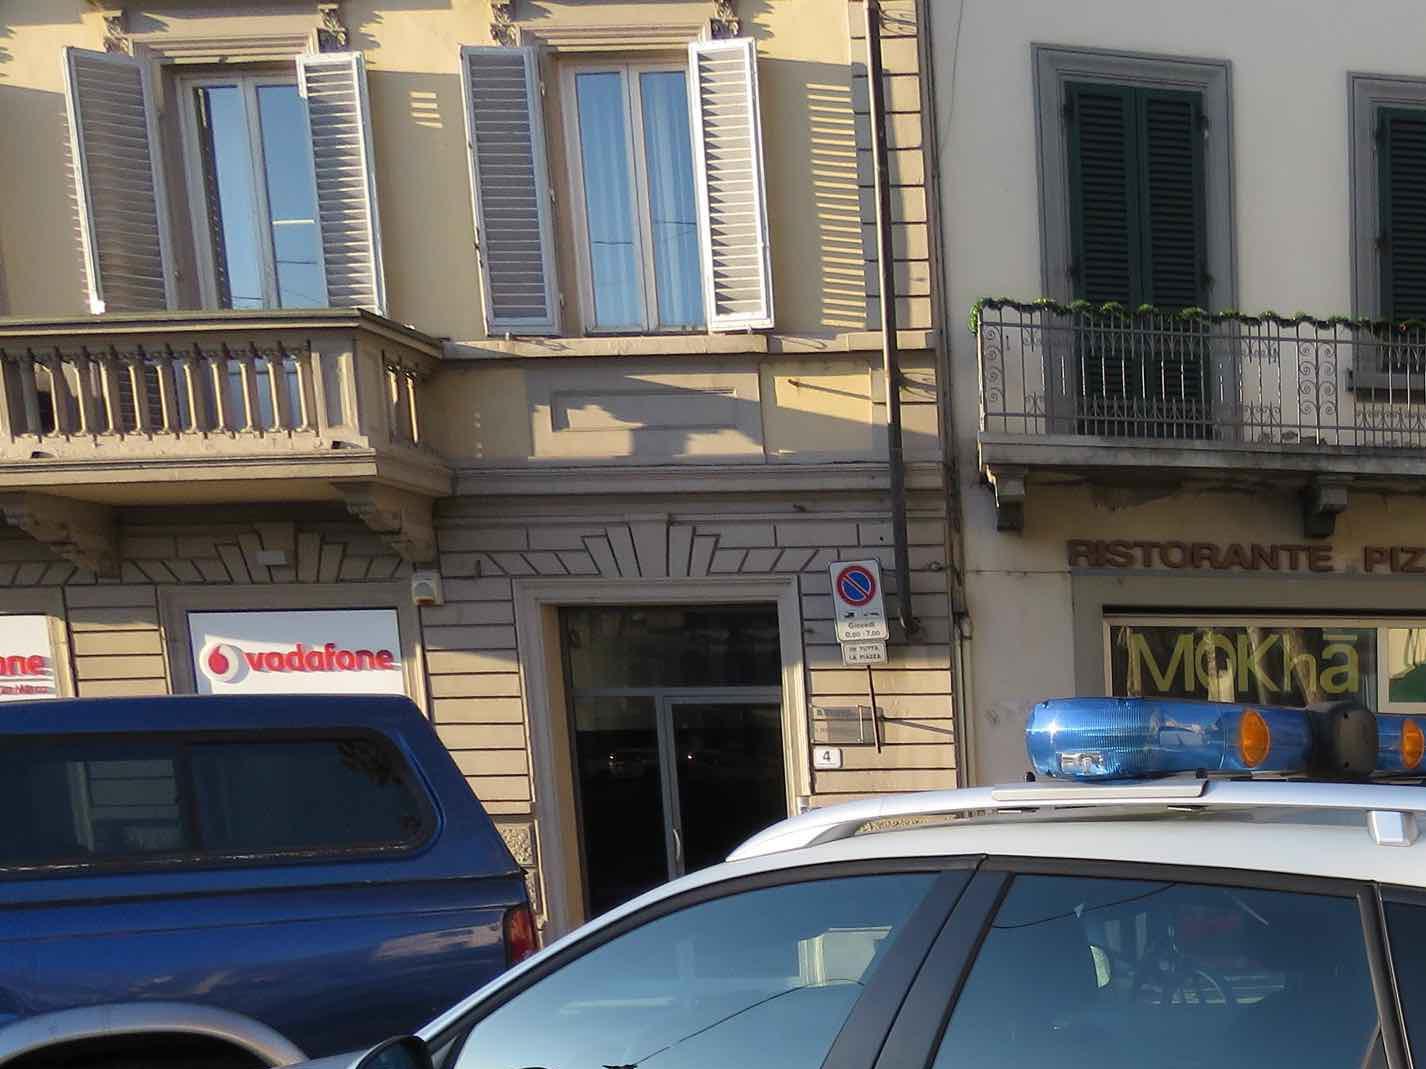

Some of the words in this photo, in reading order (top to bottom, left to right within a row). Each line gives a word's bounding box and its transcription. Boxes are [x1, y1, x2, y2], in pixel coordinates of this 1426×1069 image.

[1067, 539, 1335, 573] RISTORANTE
[246, 642, 395, 672] vodafone
[822, 750, 832, 762] 4
